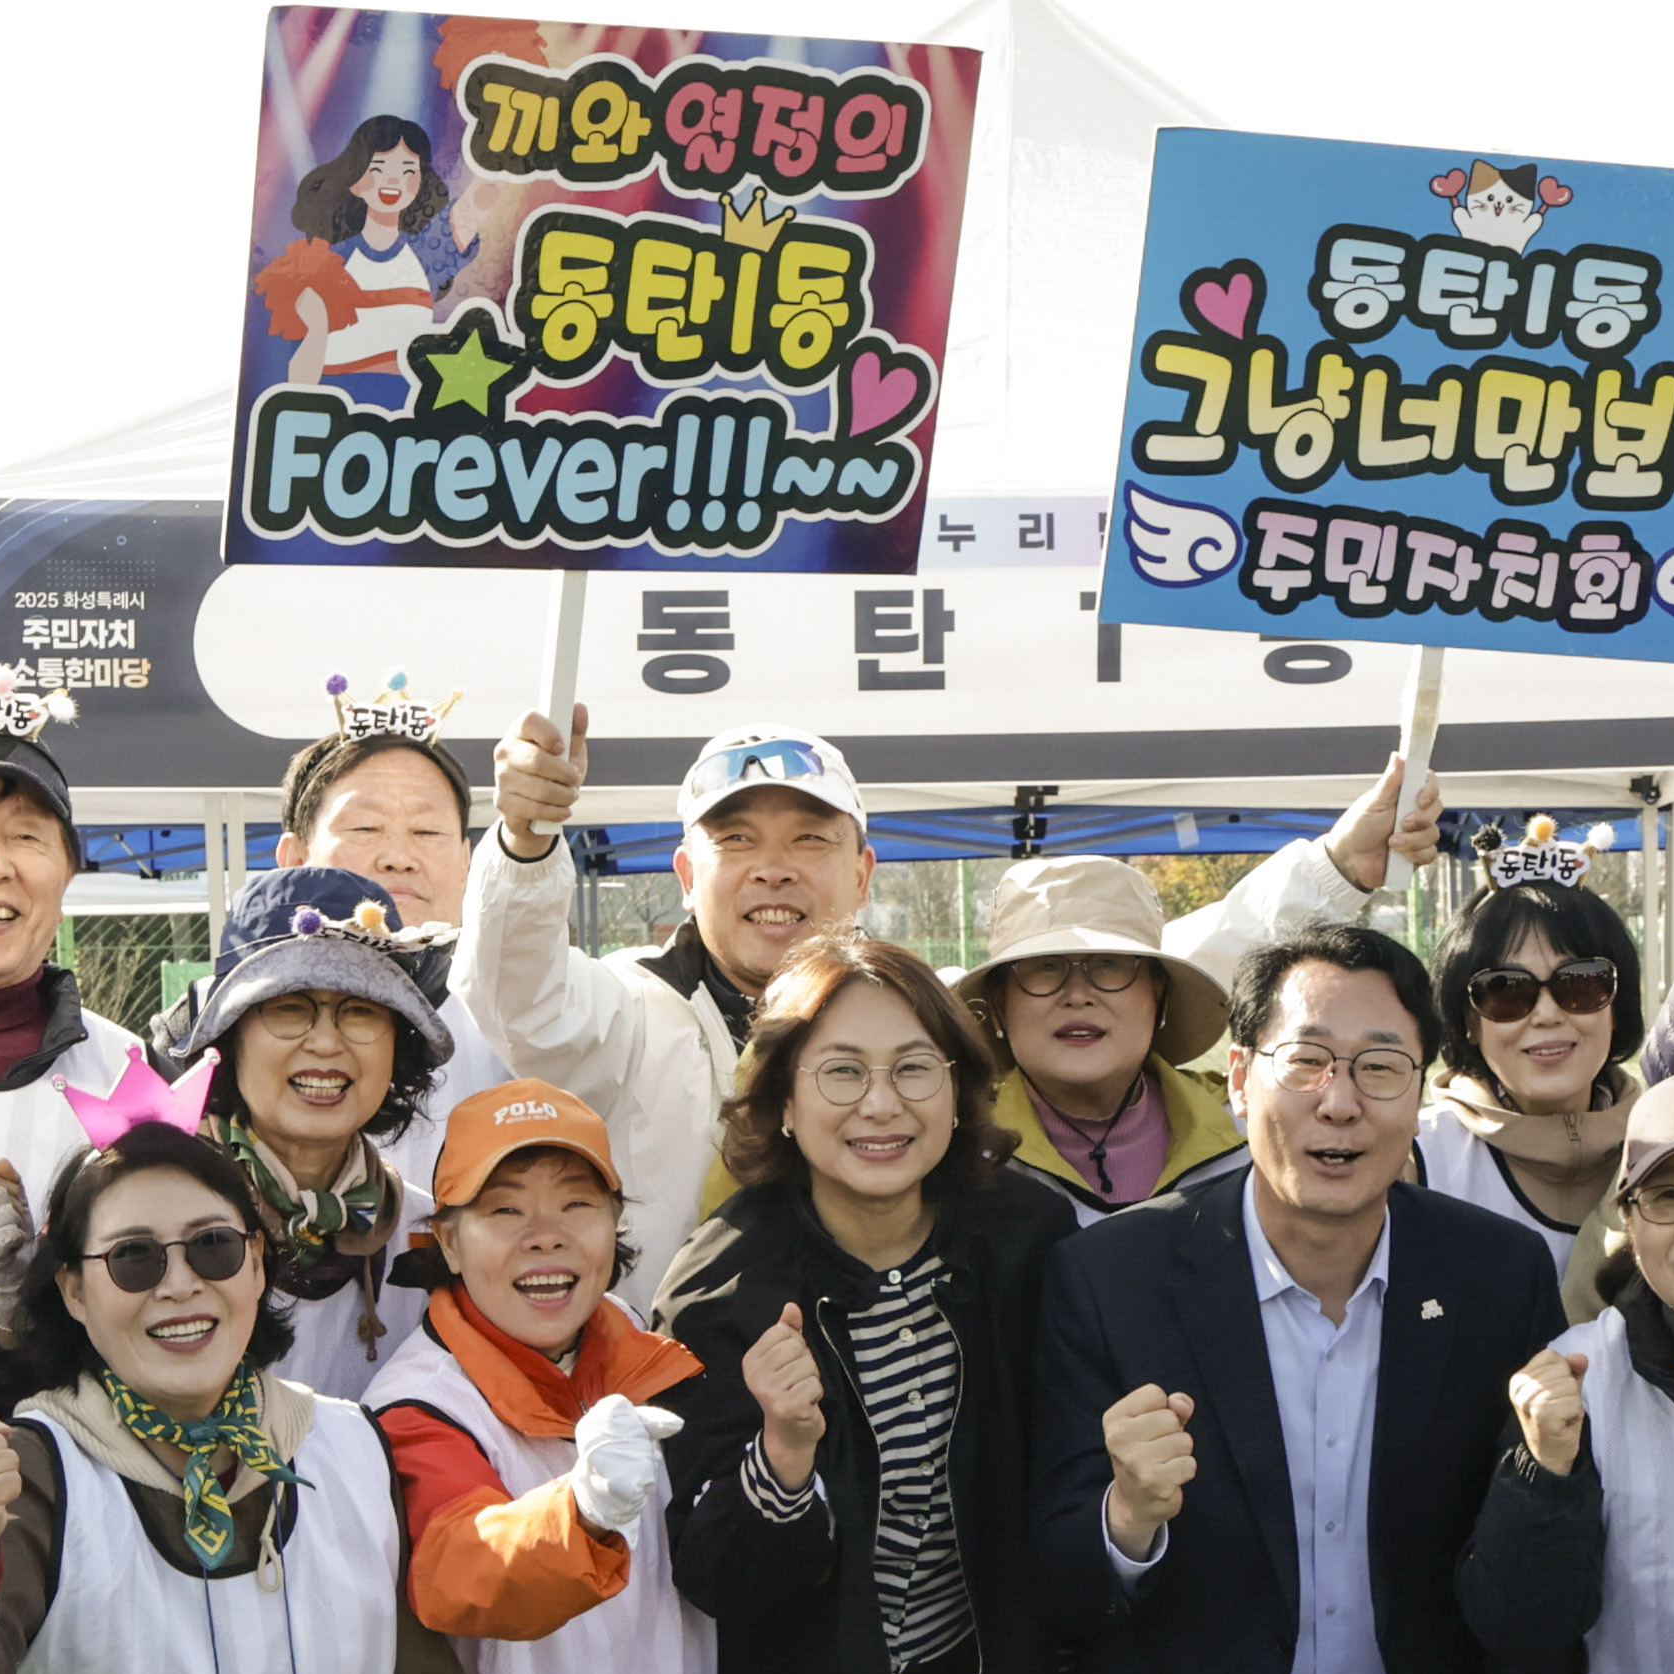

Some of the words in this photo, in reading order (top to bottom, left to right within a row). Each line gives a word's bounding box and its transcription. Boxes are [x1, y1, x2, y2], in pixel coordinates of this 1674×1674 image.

[1251, 511, 1642, 621] 주민자치회
[15, 592, 58, 608] 2025
[63, 591, 145, 610] 화성특례시
[22, 618, 136, 650] 주민자치
[13, 657, 152, 689] 소통한마당
[494, 1101, 559, 1126] POLO
